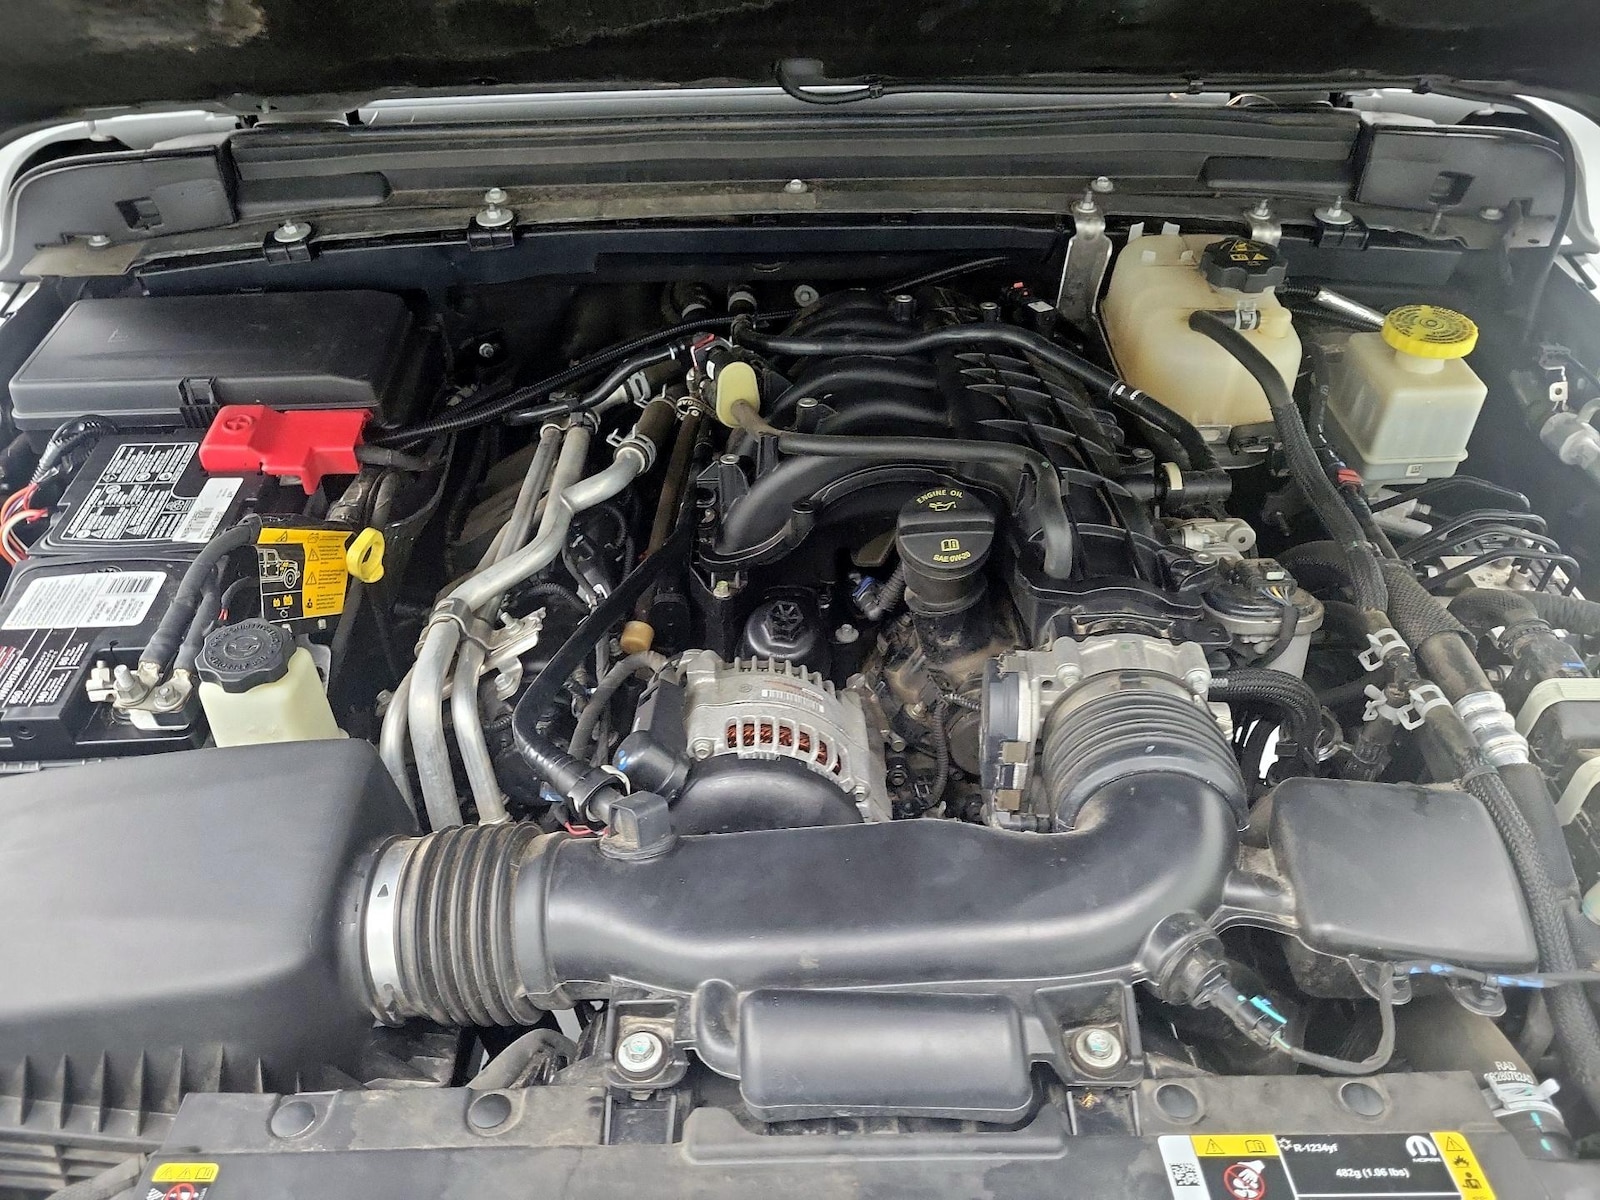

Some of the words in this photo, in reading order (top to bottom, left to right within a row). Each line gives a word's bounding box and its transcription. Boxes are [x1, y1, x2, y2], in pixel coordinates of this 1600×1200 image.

[916, 489, 947, 504] ENGINE
[950, 489, 964, 499] OIL
[933, 553, 949, 563] SAE
[1494, 1061, 1517, 1071] RAD
[1294, 1142, 1338, 1154] R-1234yf
[1335, 1167, 1362, 1179] 482g
[1363, 1167, 1388, 1179] (1.06
[1389, 1167, 1410, 1179] lbs)
